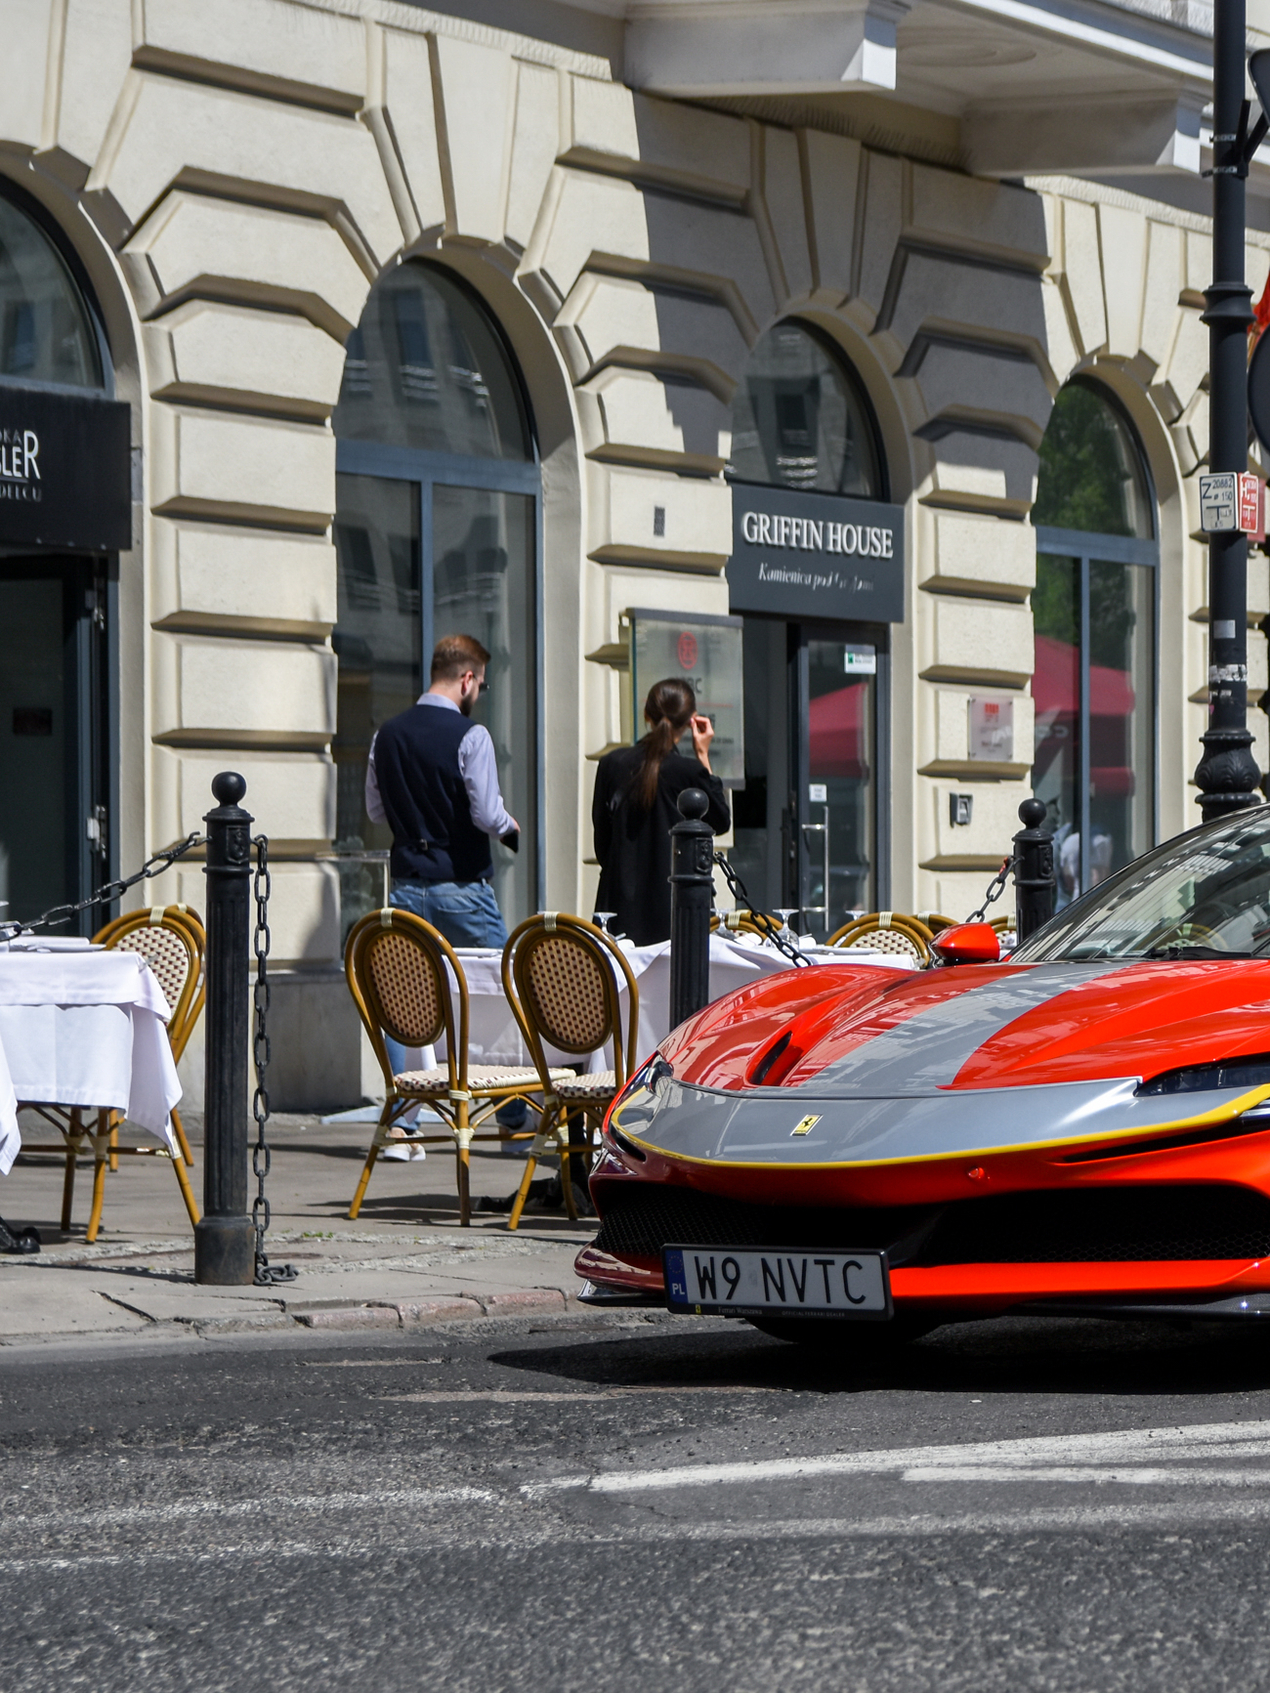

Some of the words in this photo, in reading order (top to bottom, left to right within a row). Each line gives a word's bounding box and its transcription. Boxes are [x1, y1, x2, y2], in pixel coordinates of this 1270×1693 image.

[0, 431, 41, 480] LER
[1202, 482, 1213, 500] Z
[1212, 478, 1233, 490] 20882
[743, 511, 823, 550] GRIFFIN
[827, 522, 894, 559] HOUSE
[758, 562, 812, 586] Kamienica
[672, 1283, 685, 1295] PL
[694, 1256, 741, 1300] W9
[761, 1258, 866, 1304] NVTC
[718, 1306, 736, 1314] Ferrari
[736, 1307, 763, 1315] Warszawa
